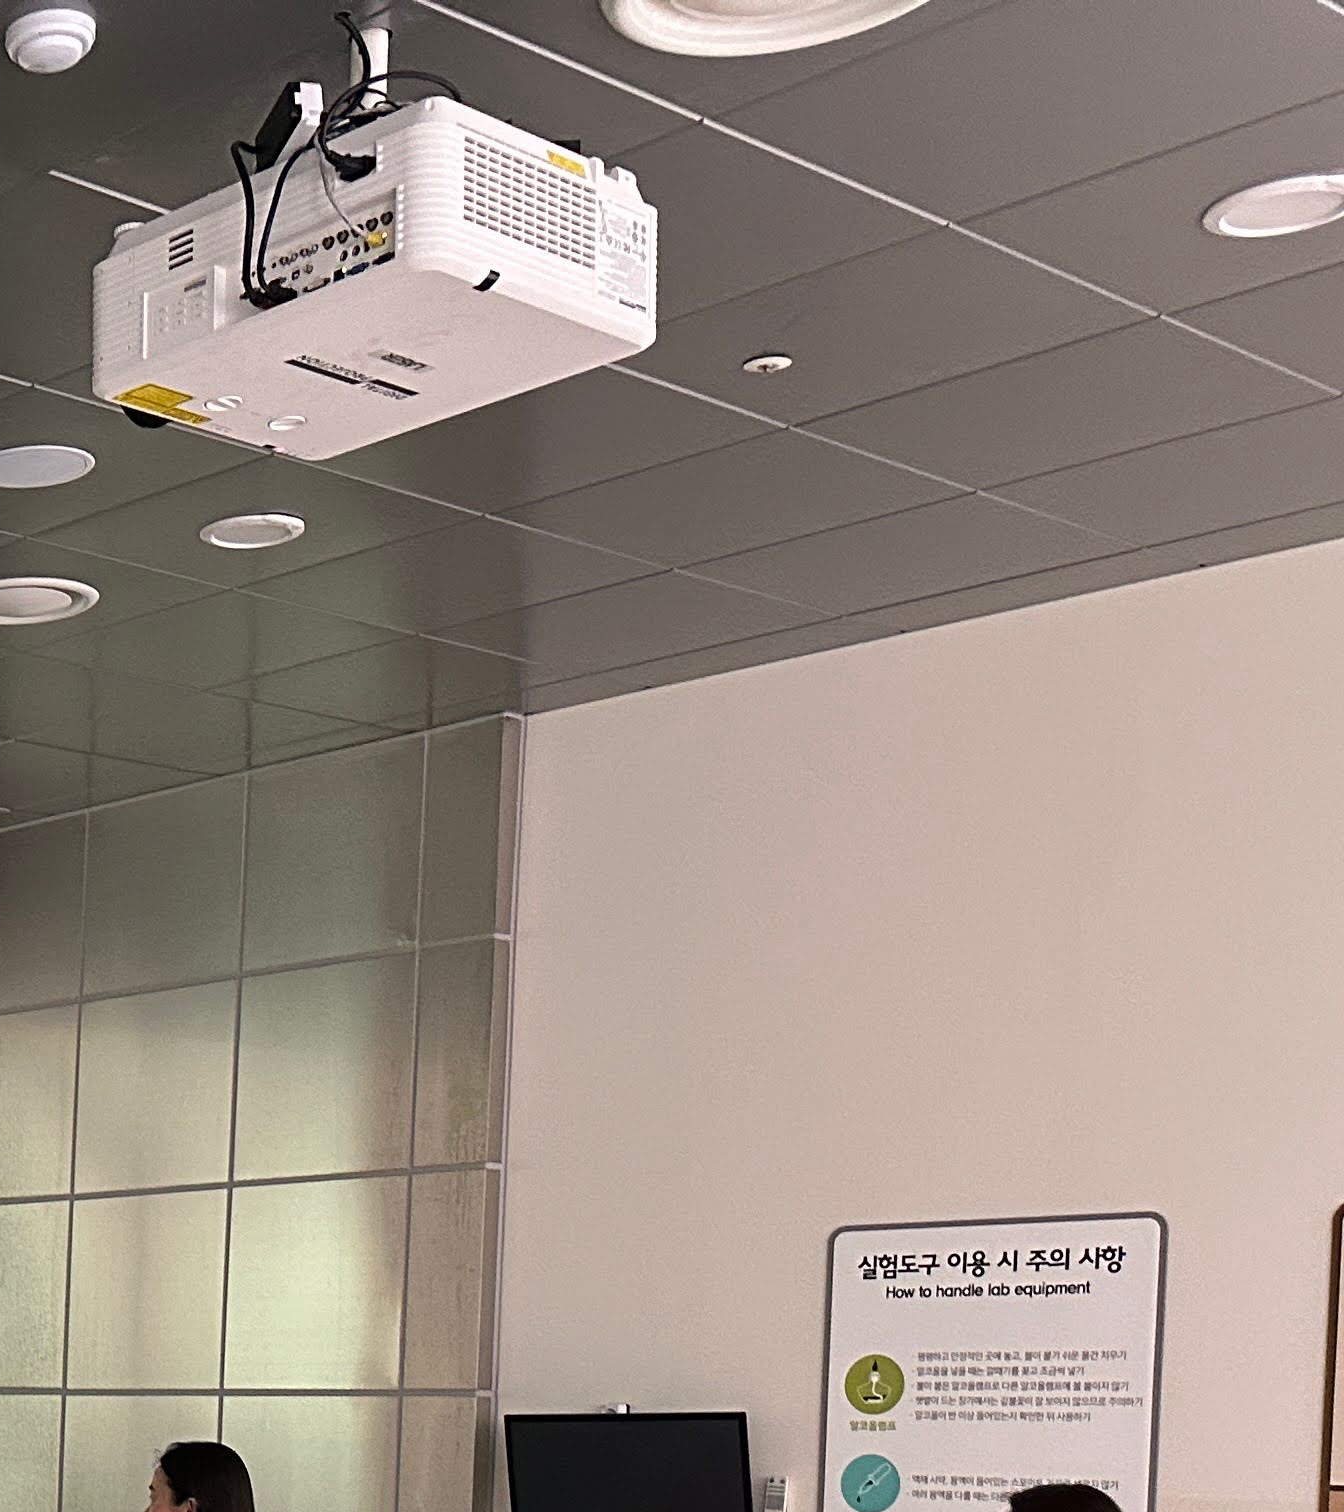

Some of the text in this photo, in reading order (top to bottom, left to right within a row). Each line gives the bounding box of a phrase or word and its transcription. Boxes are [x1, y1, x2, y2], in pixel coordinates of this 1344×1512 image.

[858, 1245, 1127, 1280] 실험도구 이용 시 주의 사항
[885, 1281, 1091, 1299] How to handle lab equipment
